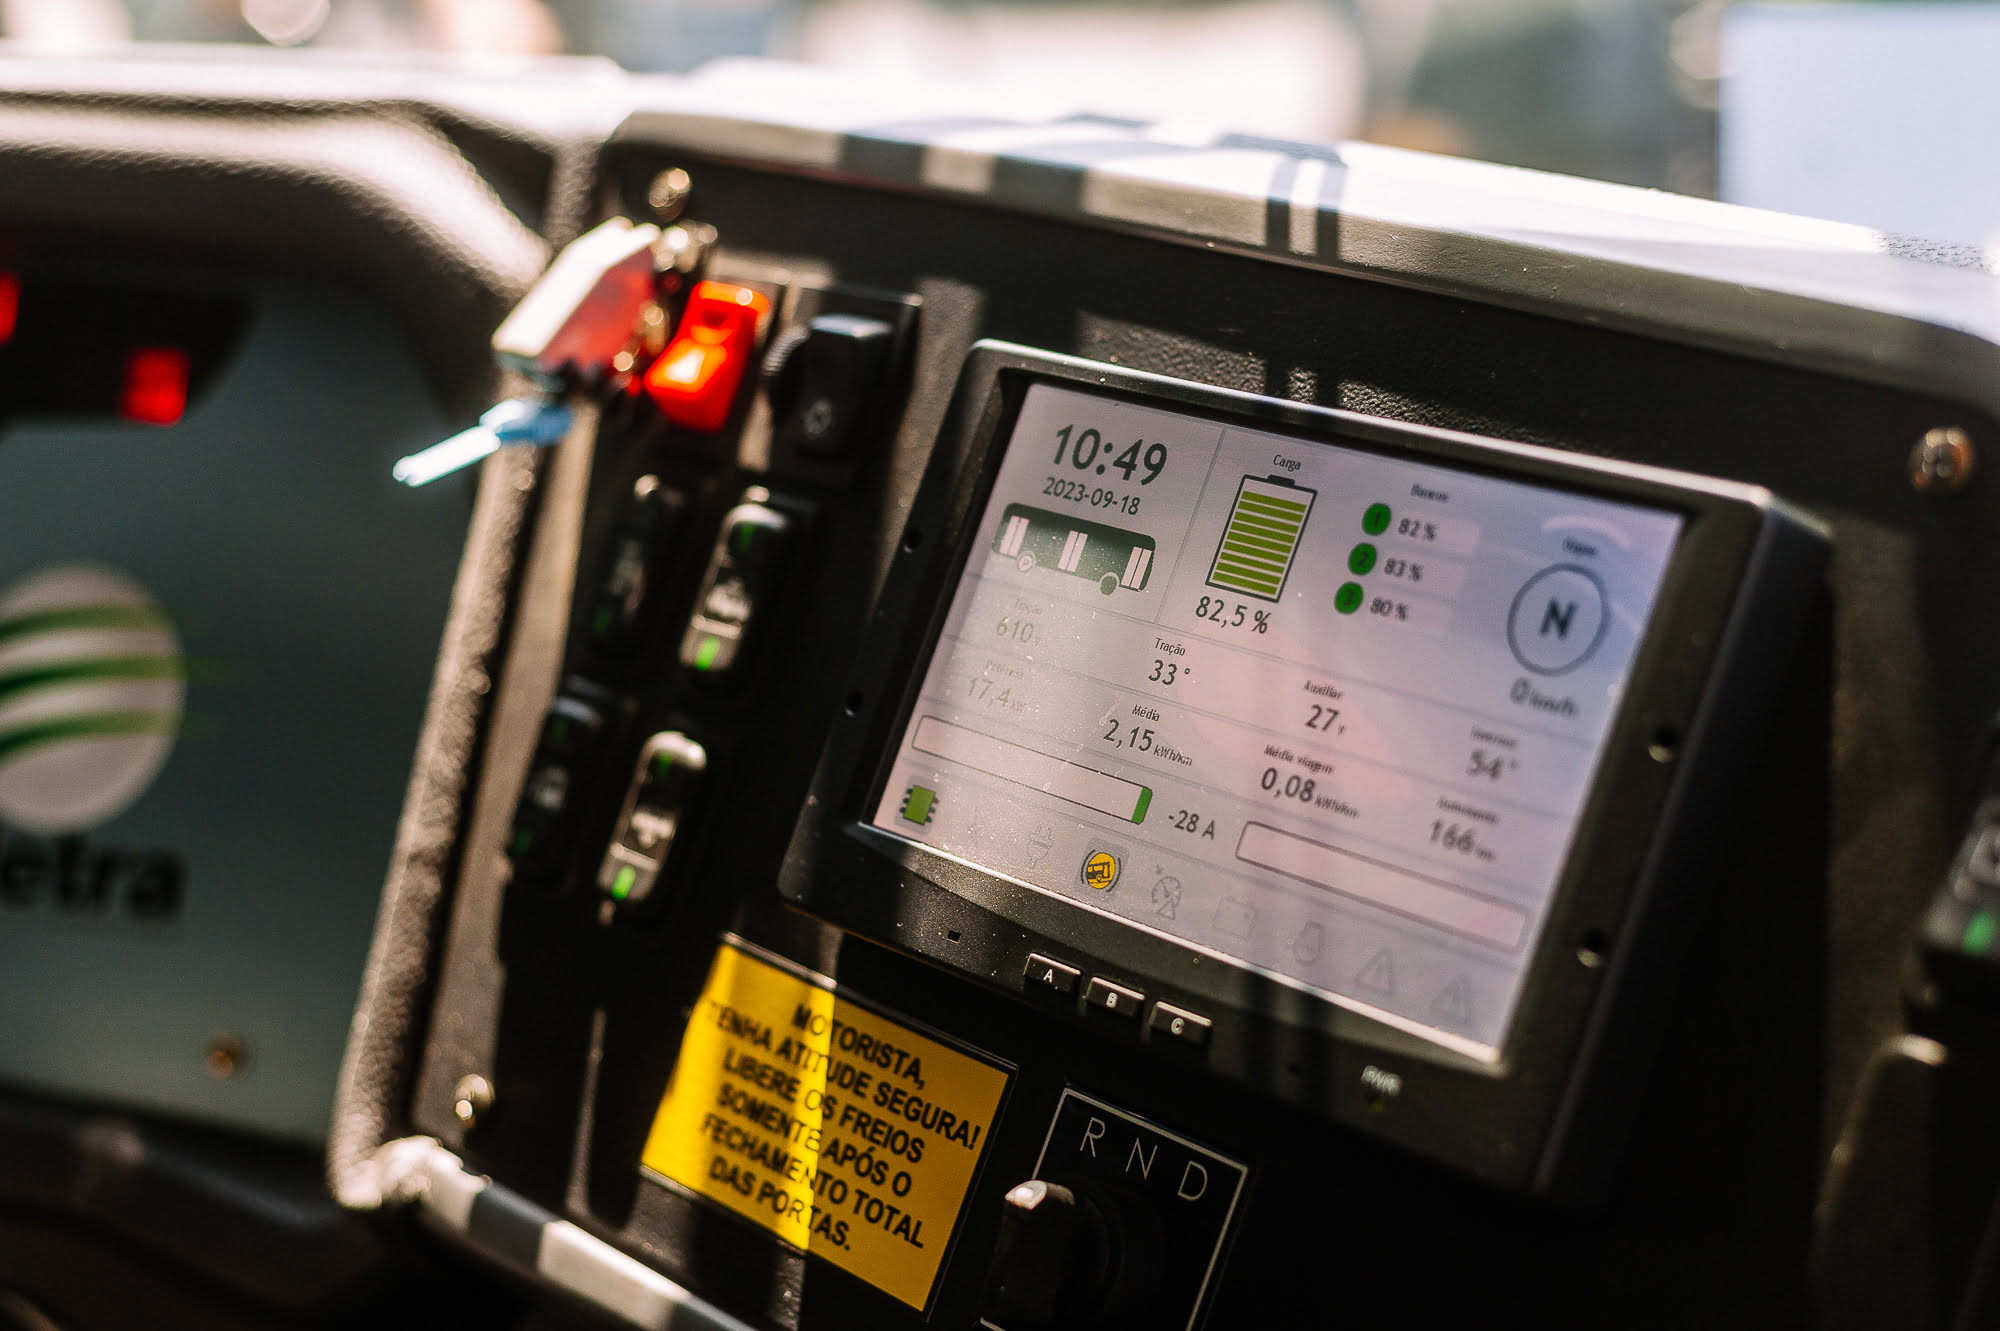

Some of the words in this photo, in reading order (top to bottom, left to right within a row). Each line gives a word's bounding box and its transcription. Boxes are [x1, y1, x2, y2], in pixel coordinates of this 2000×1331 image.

[1053, 423, 1168, 486] 10:49
[1272, 454, 1302, 473] Carga
[1042, 476, 1141, 515] 2023-09-18
[1398, 517, 1421, 538] 82
[1384, 557, 1406, 577] 83
[1195, 595, 1248, 628] 82,5
[1251, 610, 1272, 634] %
[1370, 597, 1393, 617] 80
[1539, 597, 1578, 641] N
[996, 616, 1034, 643] 610
[1154, 637, 1186, 657] Tração
[1148, 659, 1178, 686] 33
[1131, 704, 1161, 722] Média
[1305, 703, 1339, 732] 27
[1103, 718, 1156, 752] 2,15
[1261, 767, 1315, 803] 0,08
[1168, 809, 1200, 833] -28
[1202, 819, 1215, 840] A
[1043, 969, 1053, 983] A
[1106, 992, 1118, 1008] B
[1170, 1017, 1185, 1035] C
[792, 1004, 925, 1090] MOTORISTA,
[723, 1047, 801, 1103] LIBERE
[804, 1089, 838, 1120] OS
[838, 1104, 926, 1163] FREIOS
[873, 1081, 982, 1150] SEGURA!
[717, 1083, 822, 1153] SOMENTE
[822, 1137, 890, 1187] APÓS
[892, 1171, 912, 1197] O
[1080, 1116, 1106, 1158] R
[1125, 1137, 1158, 1180] N
[1178, 1160, 1208, 1201] D
[701, 1112, 849, 1205] FECHAMENTO
[852, 1188, 925, 1249] TOTAL
[709, 1155, 756, 1197] DAS
[756, 1180, 851, 1252] PORTAS.
